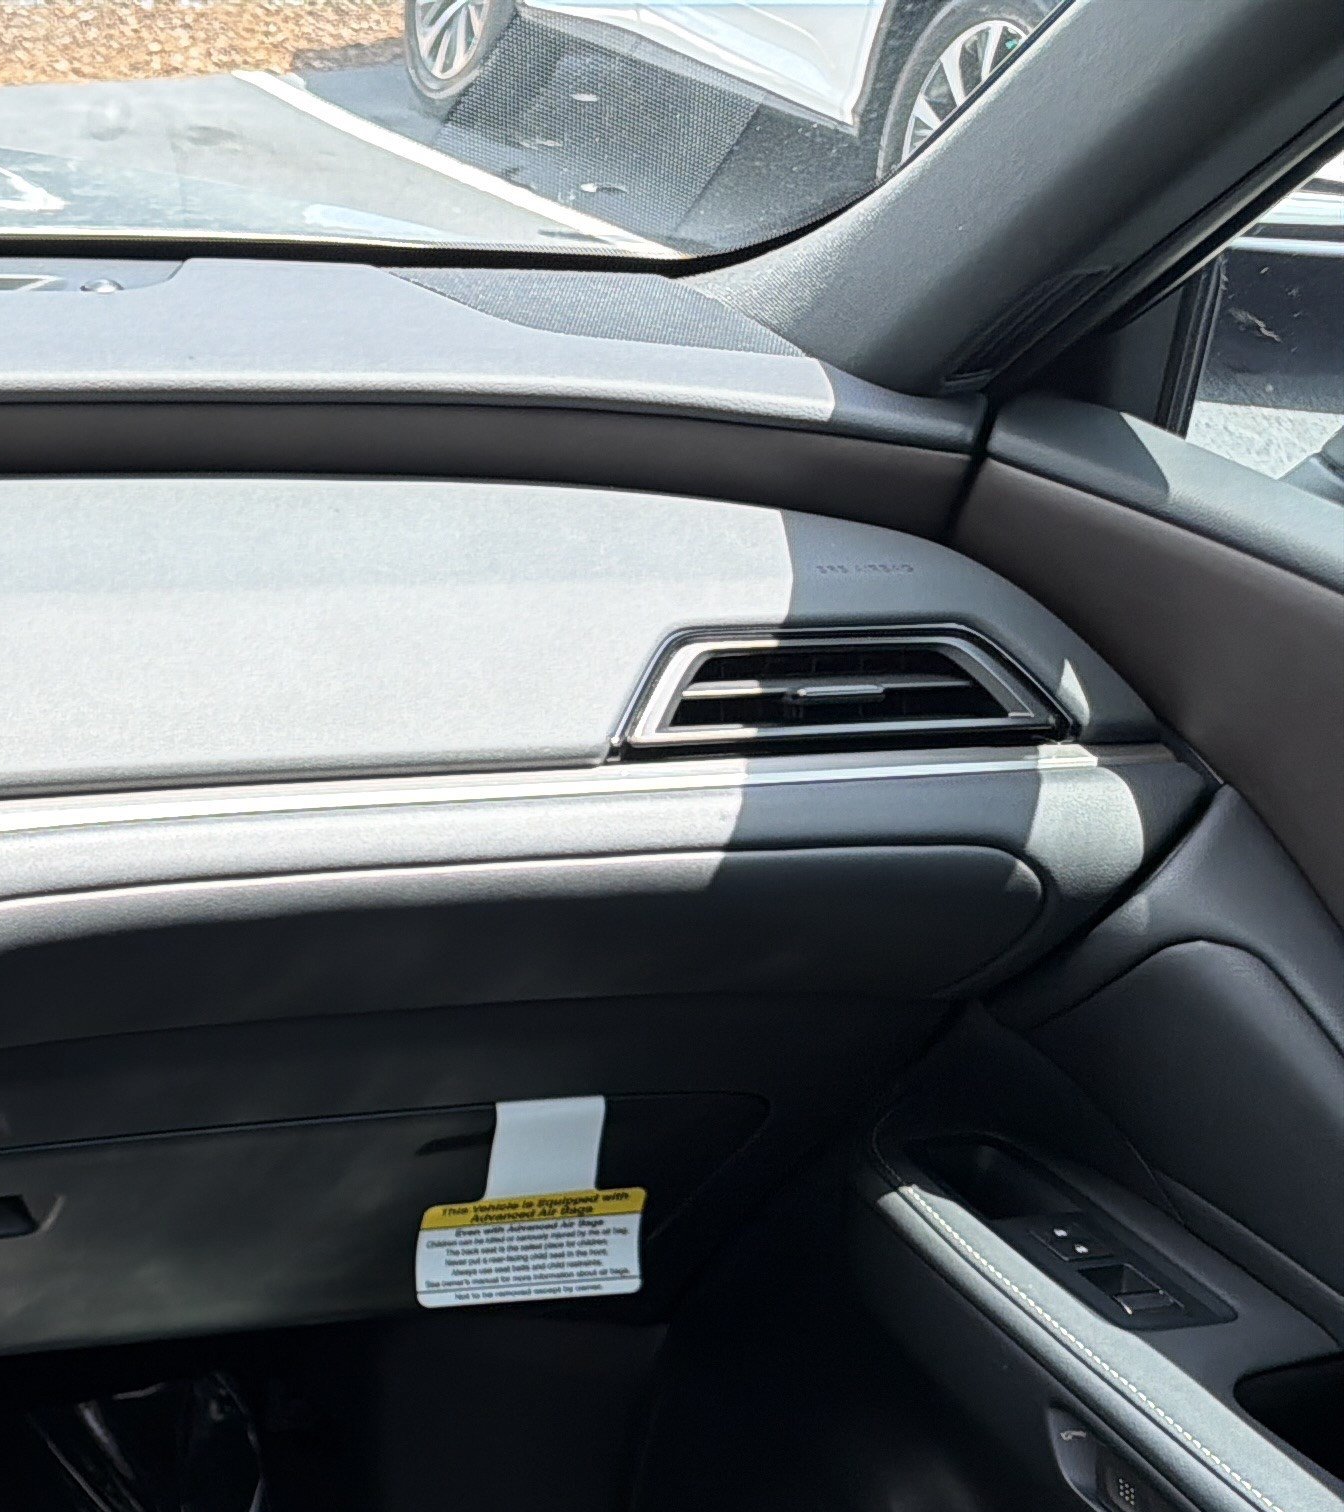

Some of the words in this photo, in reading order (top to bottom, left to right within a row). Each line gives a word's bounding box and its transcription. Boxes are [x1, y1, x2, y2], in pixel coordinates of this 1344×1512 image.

[442, 1207, 469, 1217] This
[472, 1202, 519, 1213] Vehicle
[521, 1200, 534, 1209] is
[536, 1193, 599, 1208] Equipped
[601, 1191, 629, 1202] with
[470, 1209, 536, 1224] Advanced
[538, 1207, 558, 1217] Air
[560, 1205, 594, 1218] Bags
